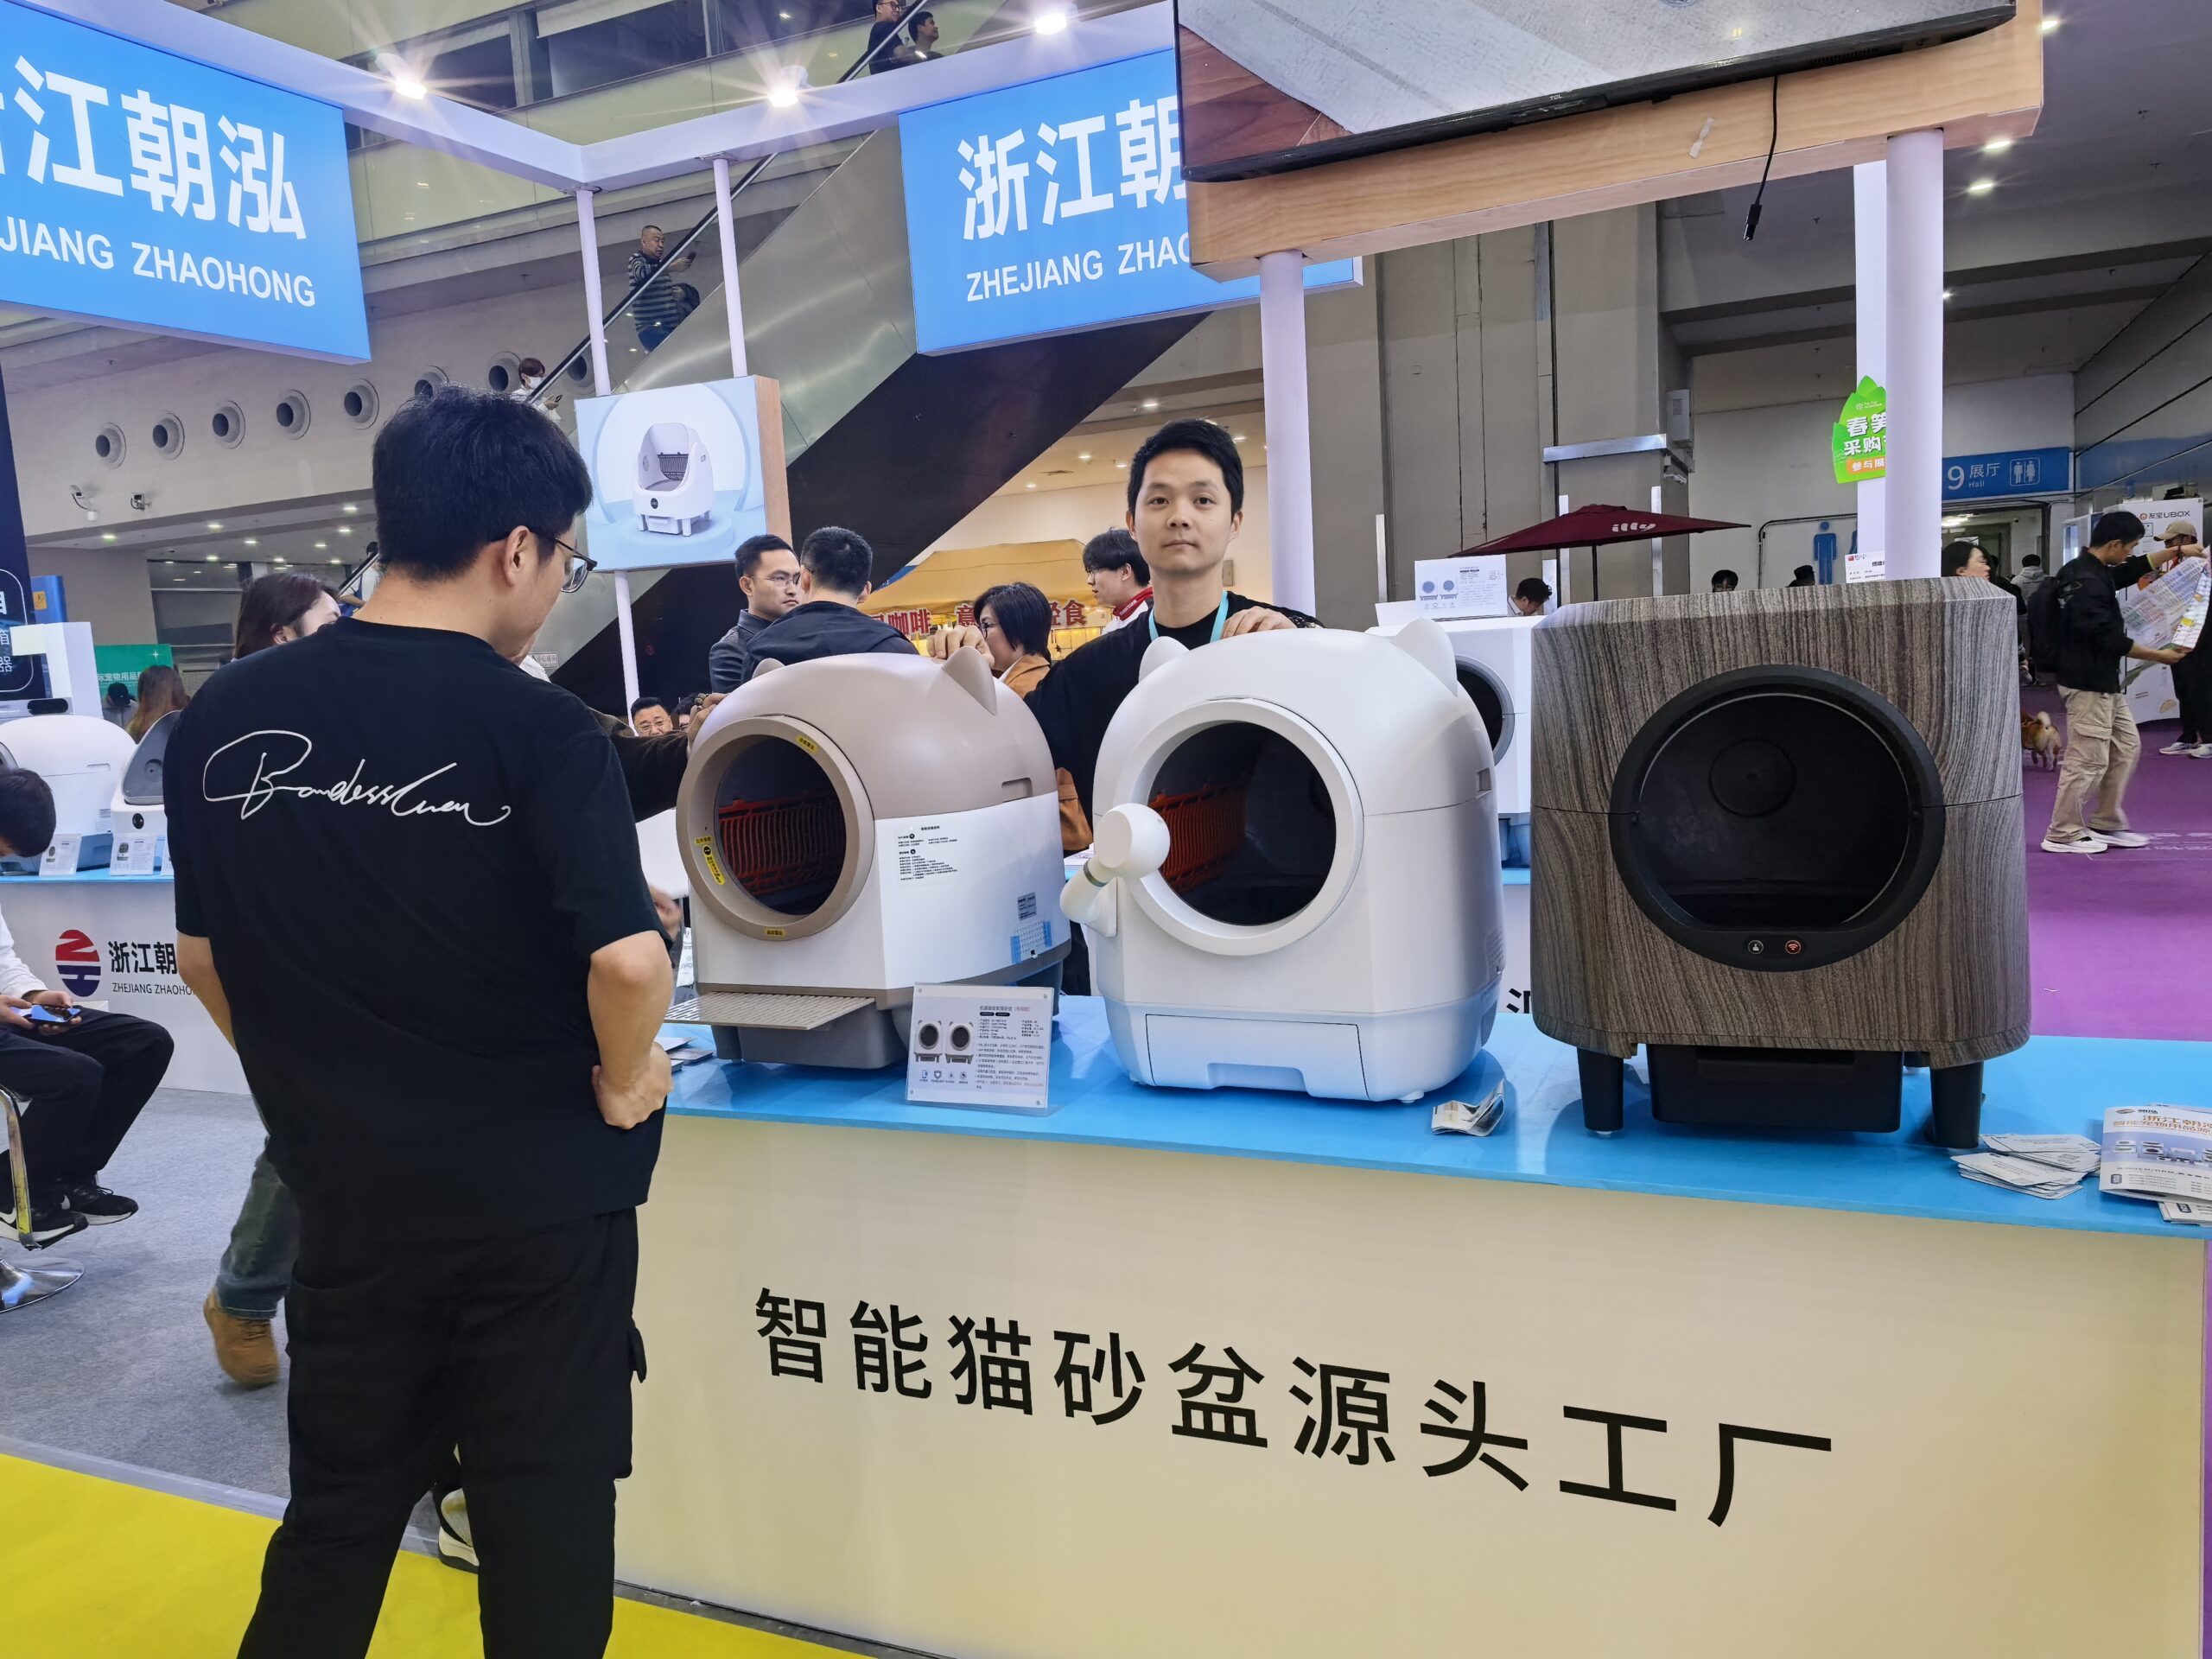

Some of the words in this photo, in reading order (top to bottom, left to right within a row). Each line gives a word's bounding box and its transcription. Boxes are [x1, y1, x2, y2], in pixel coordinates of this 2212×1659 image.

[0, 55, 307, 240] 江朝泓
[957, 95, 1186, 240] 浙江朝
[0, 216, 113, 270] JIANG
[132, 242, 316, 307] ZHAOHONG
[967, 250, 1103, 302] ZHEJIANG
[1844, 435, 1885, 456] 采购
[1947, 465, 1965, 490] 9
[1969, 462, 2001, 479] 展厅
[1968, 480, 1985, 488] Hall
[1612, 522, 1656, 531] illy
[108, 941, 178, 975] 浙江朝
[112, 982, 151, 995] ZHEJIANG
[155, 984, 195, 995] ZHAOHO
[755, 1287, 1833, 1529] 智能猫砂盆源头工厂
